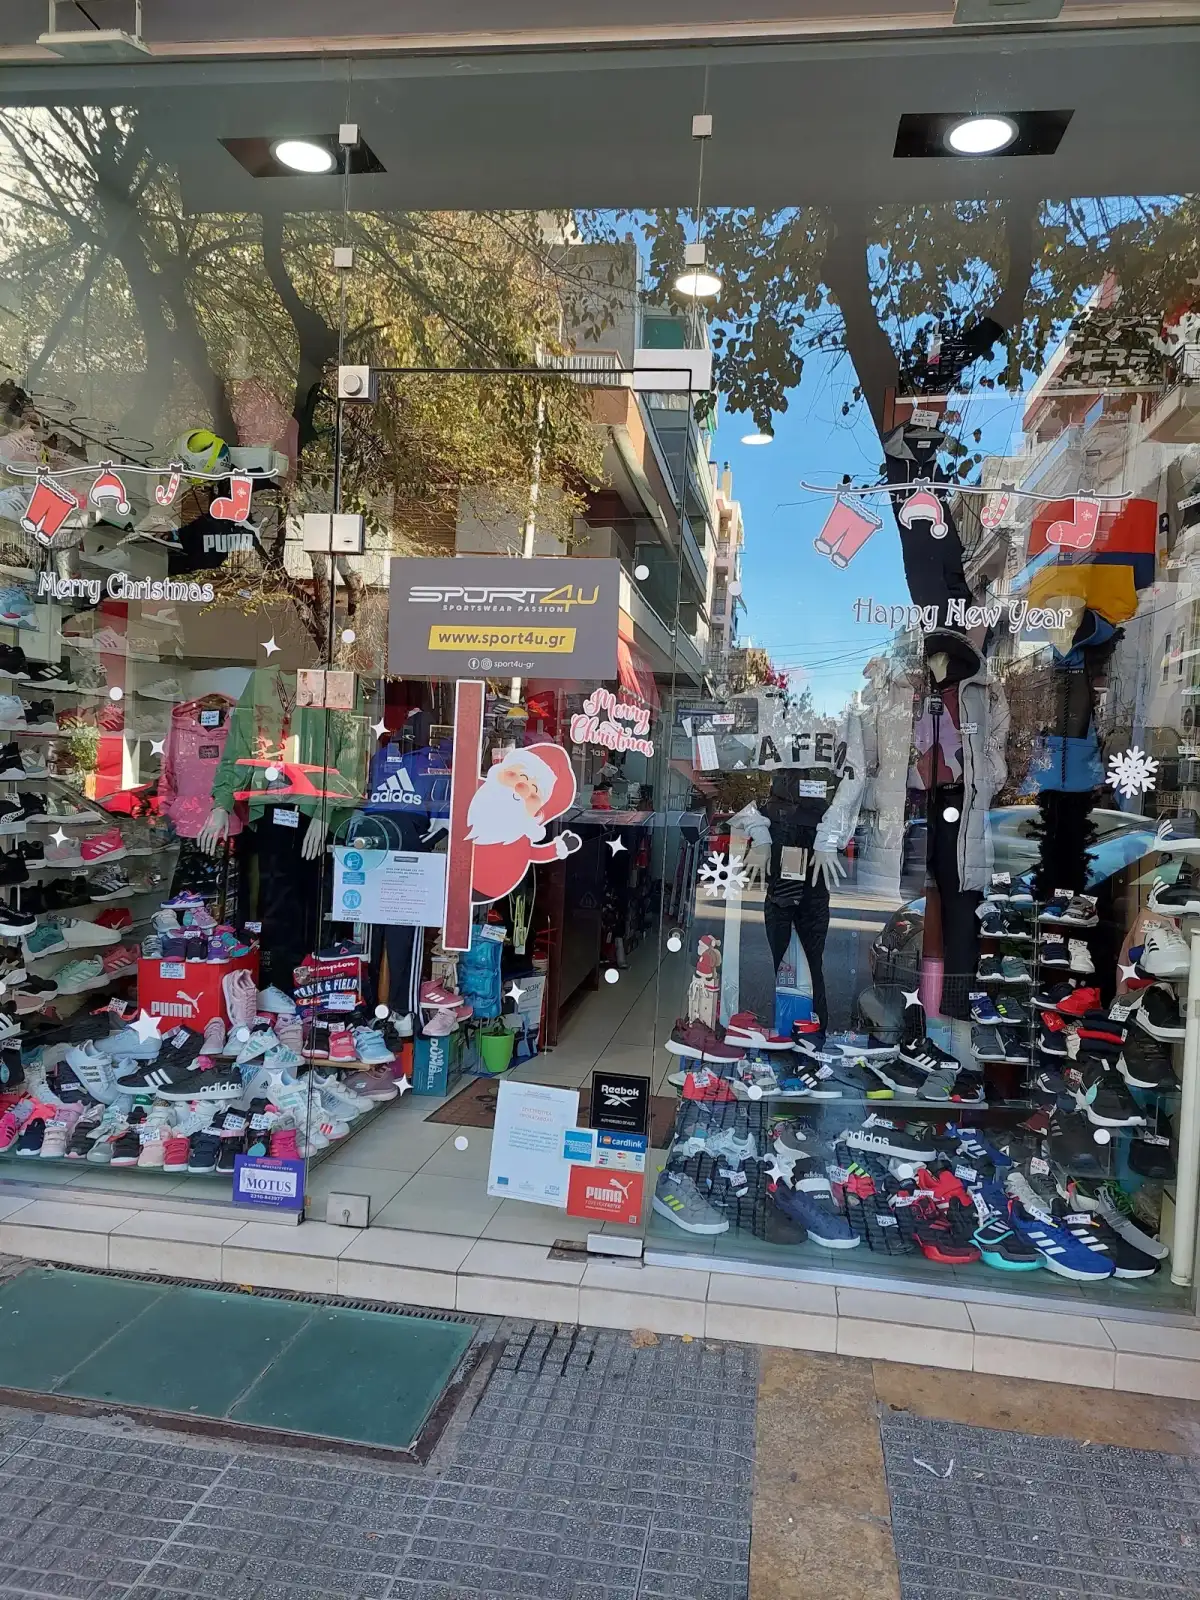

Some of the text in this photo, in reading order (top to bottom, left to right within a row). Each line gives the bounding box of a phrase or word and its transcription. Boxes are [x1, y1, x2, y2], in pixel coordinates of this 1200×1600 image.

[203, 533, 254, 552] PUMA
[38, 571, 214, 604] Merry Christmas
[442, 604, 563, 613] SPORTSWEAR PASSION
[853, 597, 1072, 633] Happy New Year
[438, 632, 566, 648] www.sport4u.gr
[493, 660, 535, 669] sport4u-gr
[583, 688, 650, 735] Merry
[570, 713, 654, 757] Christmas
[370, 789, 422, 805] adidas
[333, 978, 358, 990] FIELD
[151, 1001, 192, 1018] PUMA
[200, 1081, 242, 1094] adidas
[601, 1084, 640, 1097] Reebok
[612, 1138, 643, 1148] cardlink
[247, 1178, 292, 1193] MOTUS
[585, 1186, 622, 1203] PUMA
